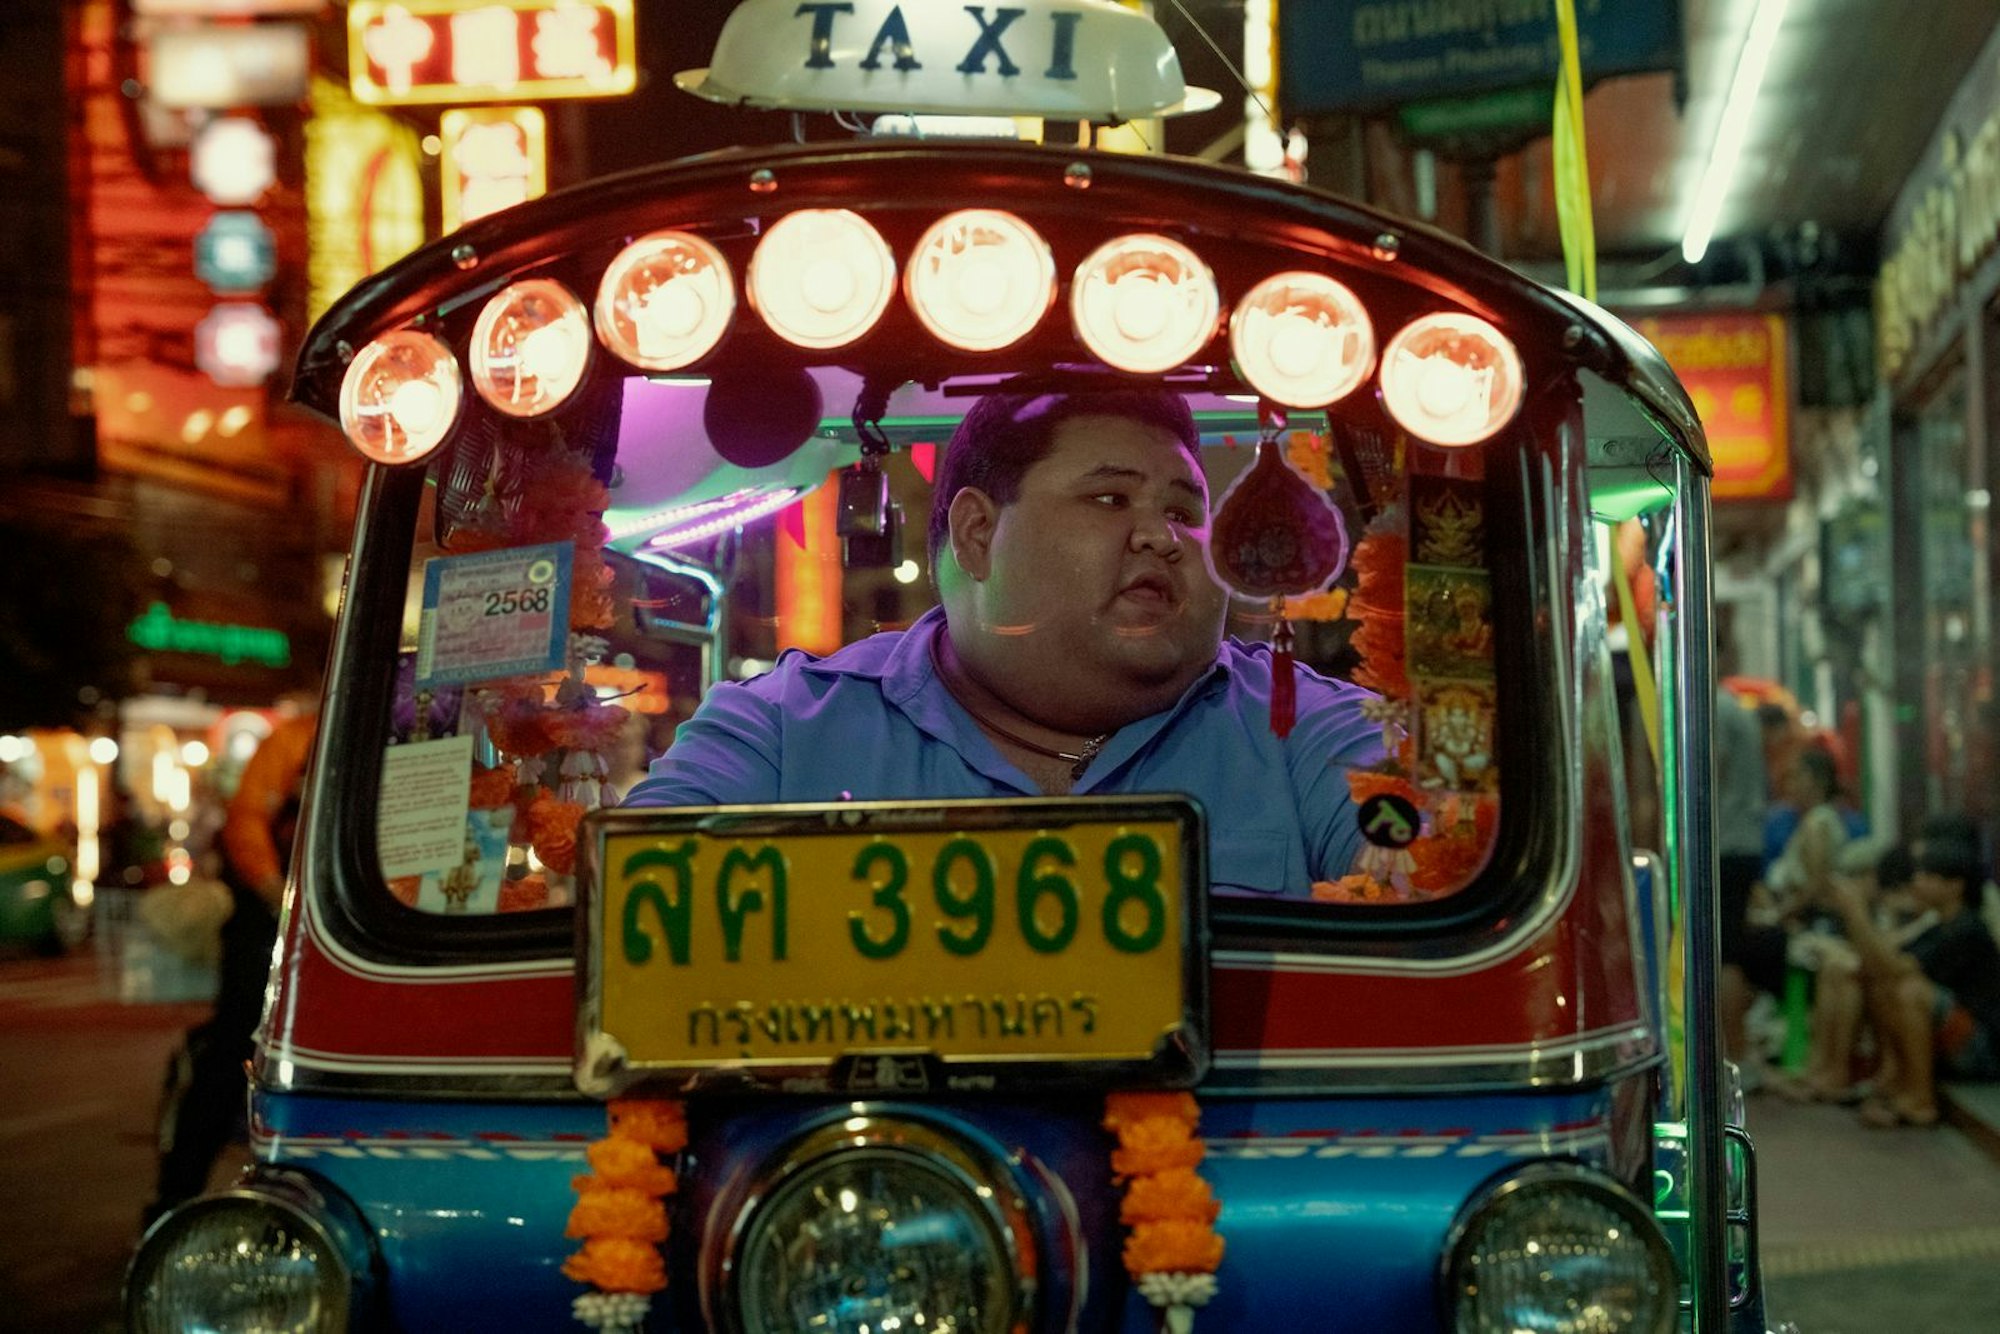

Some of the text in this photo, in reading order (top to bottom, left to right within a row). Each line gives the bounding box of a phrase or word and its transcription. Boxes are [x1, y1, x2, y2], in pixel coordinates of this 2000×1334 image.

[794, 2, 1083, 80] TAXI
[485, 588, 549, 616] 2568
[622, 837, 1166, 966] สต 3968
[688, 996, 1099, 1060] กรุงเทพมหานคร
